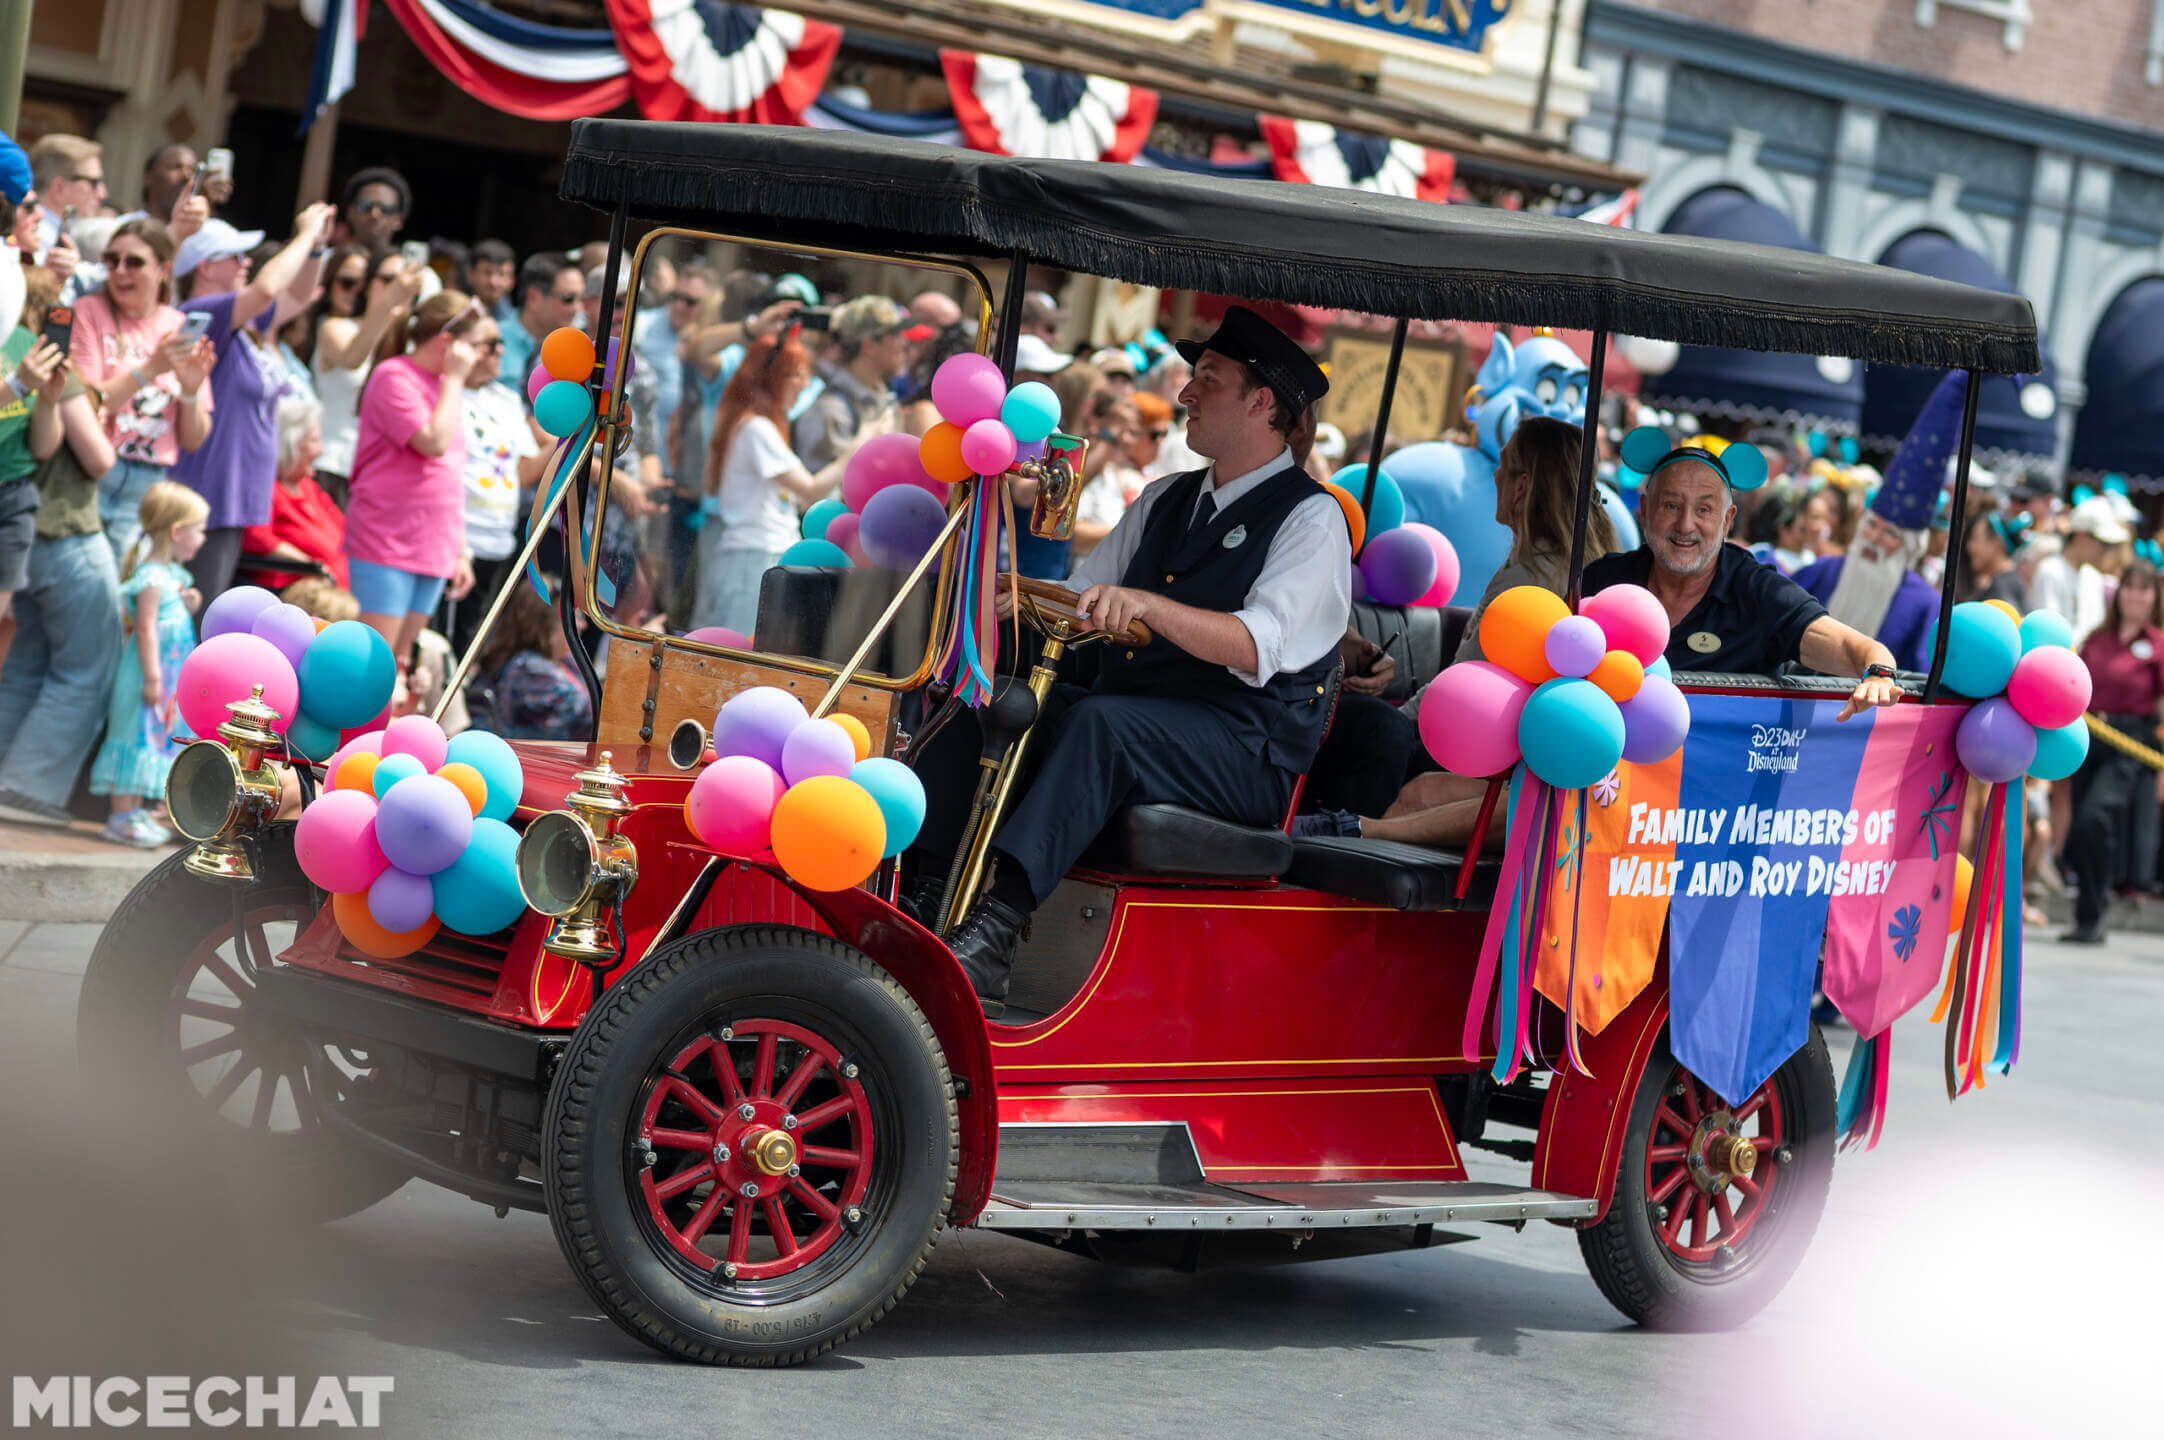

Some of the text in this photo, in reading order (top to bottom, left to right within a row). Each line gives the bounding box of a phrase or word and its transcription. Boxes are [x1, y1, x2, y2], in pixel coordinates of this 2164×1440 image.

[1746, 750, 1799, 774] Disneyland
[1628, 802, 1896, 846] FAMILY MEMBERS OF
[1608, 856, 1896, 898] WALT AND ROY DISNEY
